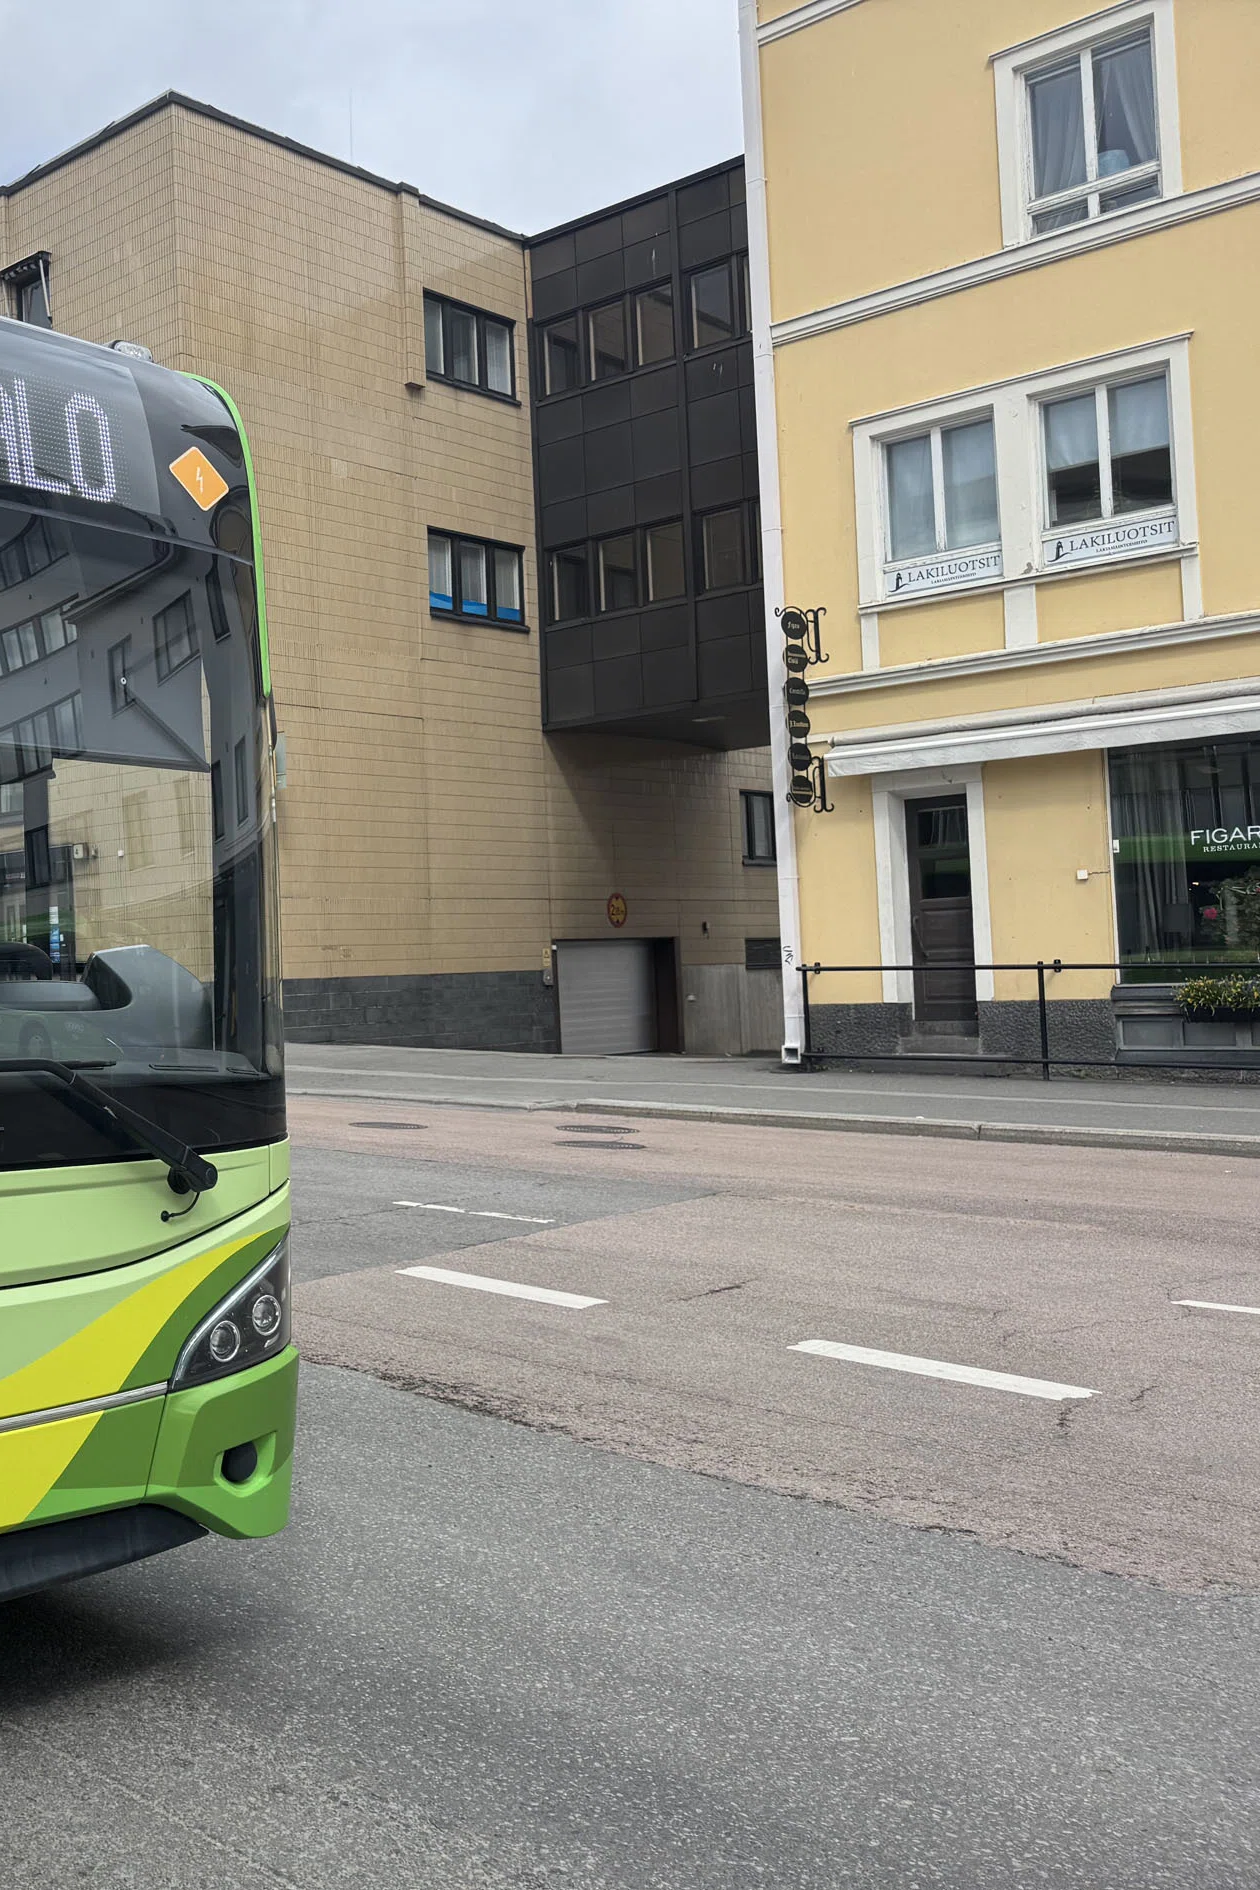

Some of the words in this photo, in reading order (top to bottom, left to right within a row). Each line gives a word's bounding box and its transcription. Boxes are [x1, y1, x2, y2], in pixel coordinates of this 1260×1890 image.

[1070, 520, 1175, 552] LAKILUOTSIT
[907, 554, 1001, 583] LAKILUOTSIT
[1203, 842, 1260, 853] RESTAURA
